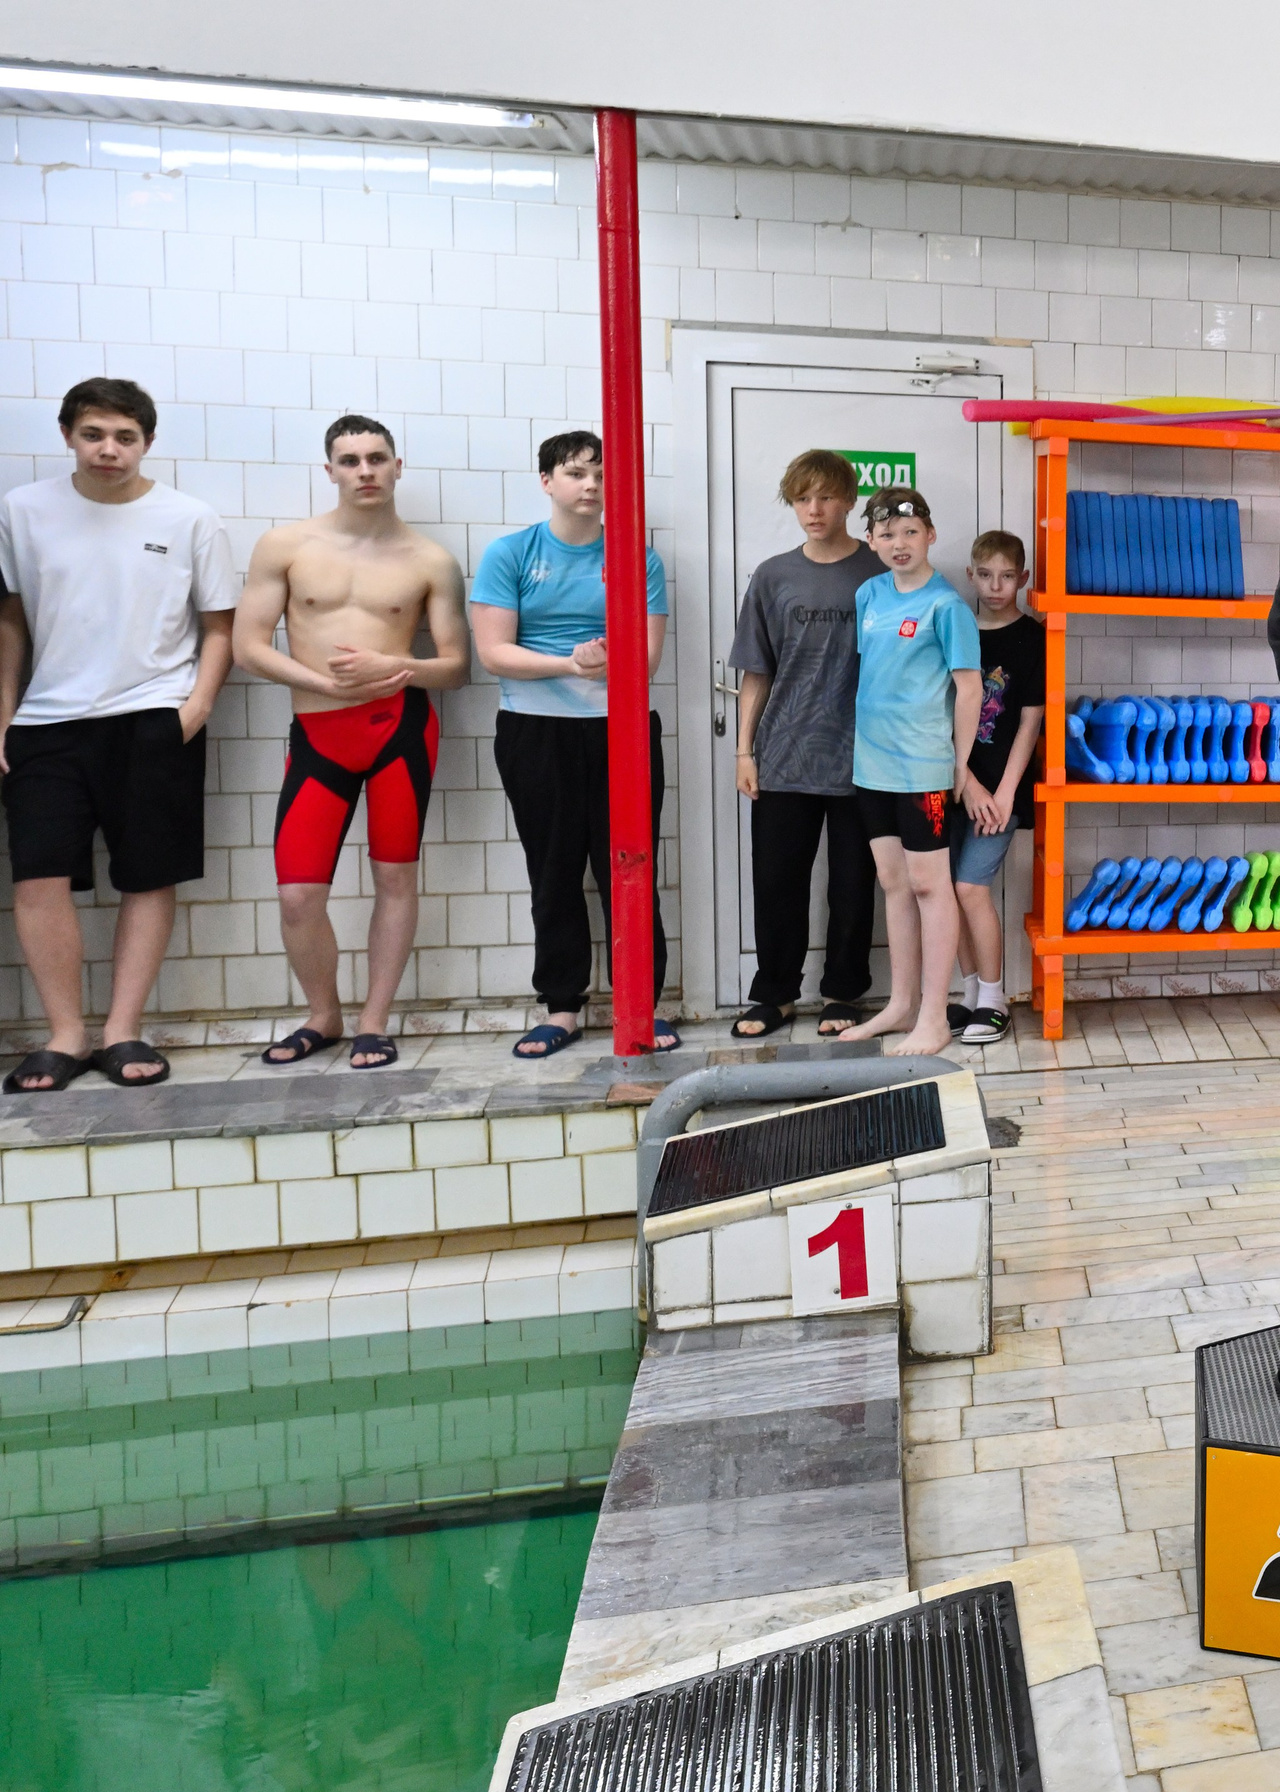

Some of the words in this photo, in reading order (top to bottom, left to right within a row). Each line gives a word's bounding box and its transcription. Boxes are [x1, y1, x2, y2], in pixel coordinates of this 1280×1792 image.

[851, 463, 912, 489] ХОД
[793, 605, 857, 625] Creativ
[808, 1207, 869, 1300] 1
